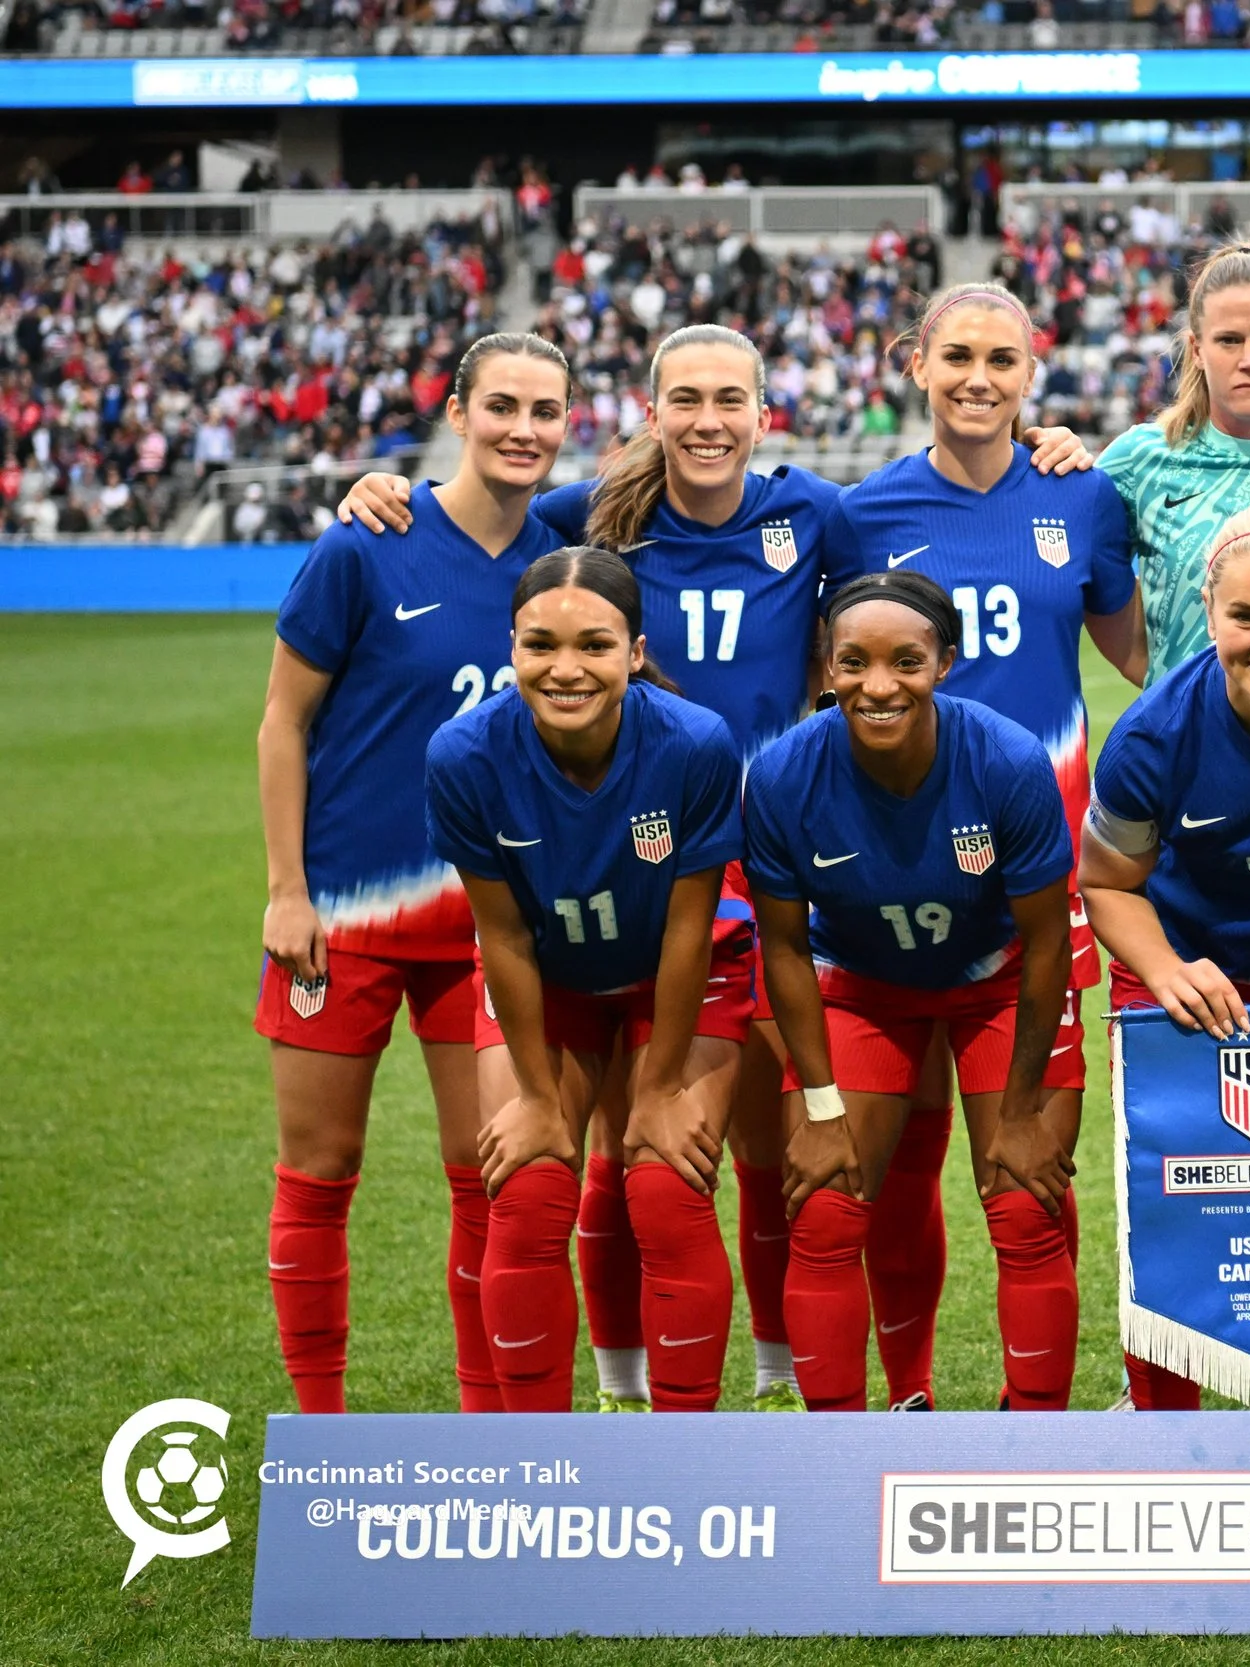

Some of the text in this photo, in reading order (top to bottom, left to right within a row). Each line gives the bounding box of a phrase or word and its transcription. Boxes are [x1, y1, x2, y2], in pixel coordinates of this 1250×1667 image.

[764, 530, 791, 547] USA
[1036, 529, 1065, 545] USA
[680, 589, 745, 661] 17
[952, 584, 1021, 659] 13
[634, 821, 668, 841] USA
[955, 834, 991, 853] USA
[554, 890, 618, 943] 11
[880, 902, 952, 950] 19
[1201, 1206, 1244, 1215] PRESENTED
[357, 1504, 776, 1567] COLUMBUS, OH
